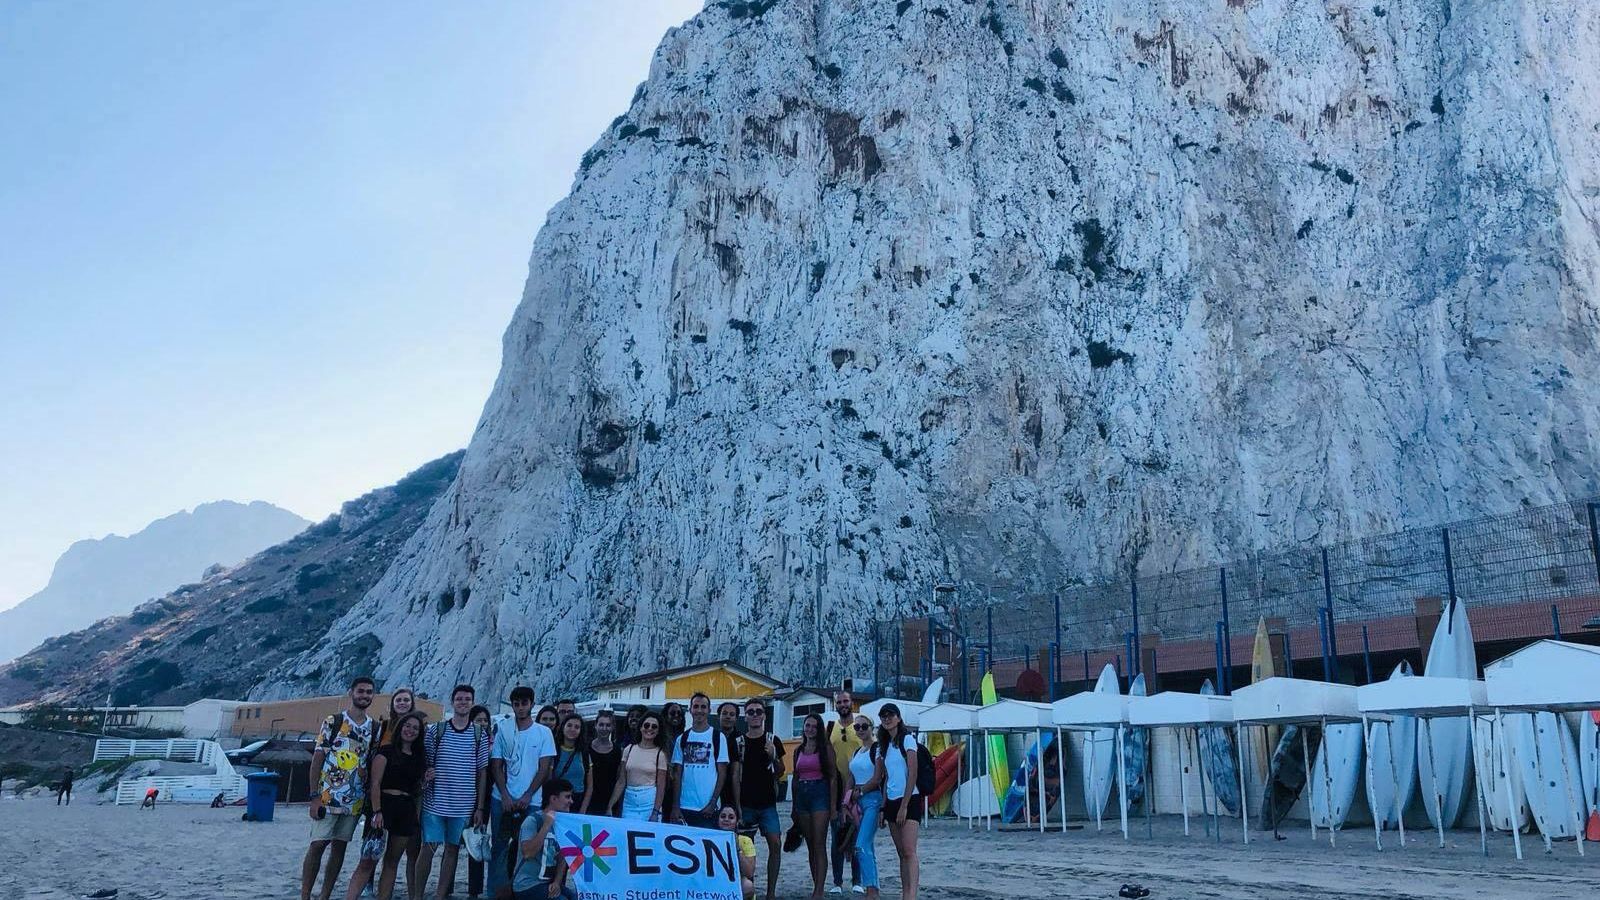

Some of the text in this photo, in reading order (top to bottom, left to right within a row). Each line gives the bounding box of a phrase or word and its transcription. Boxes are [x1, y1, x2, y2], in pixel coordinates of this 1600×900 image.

[627, 830, 736, 882] ESN
[626, 889, 681, 900] Student
[686, 889, 740, 900] Network
